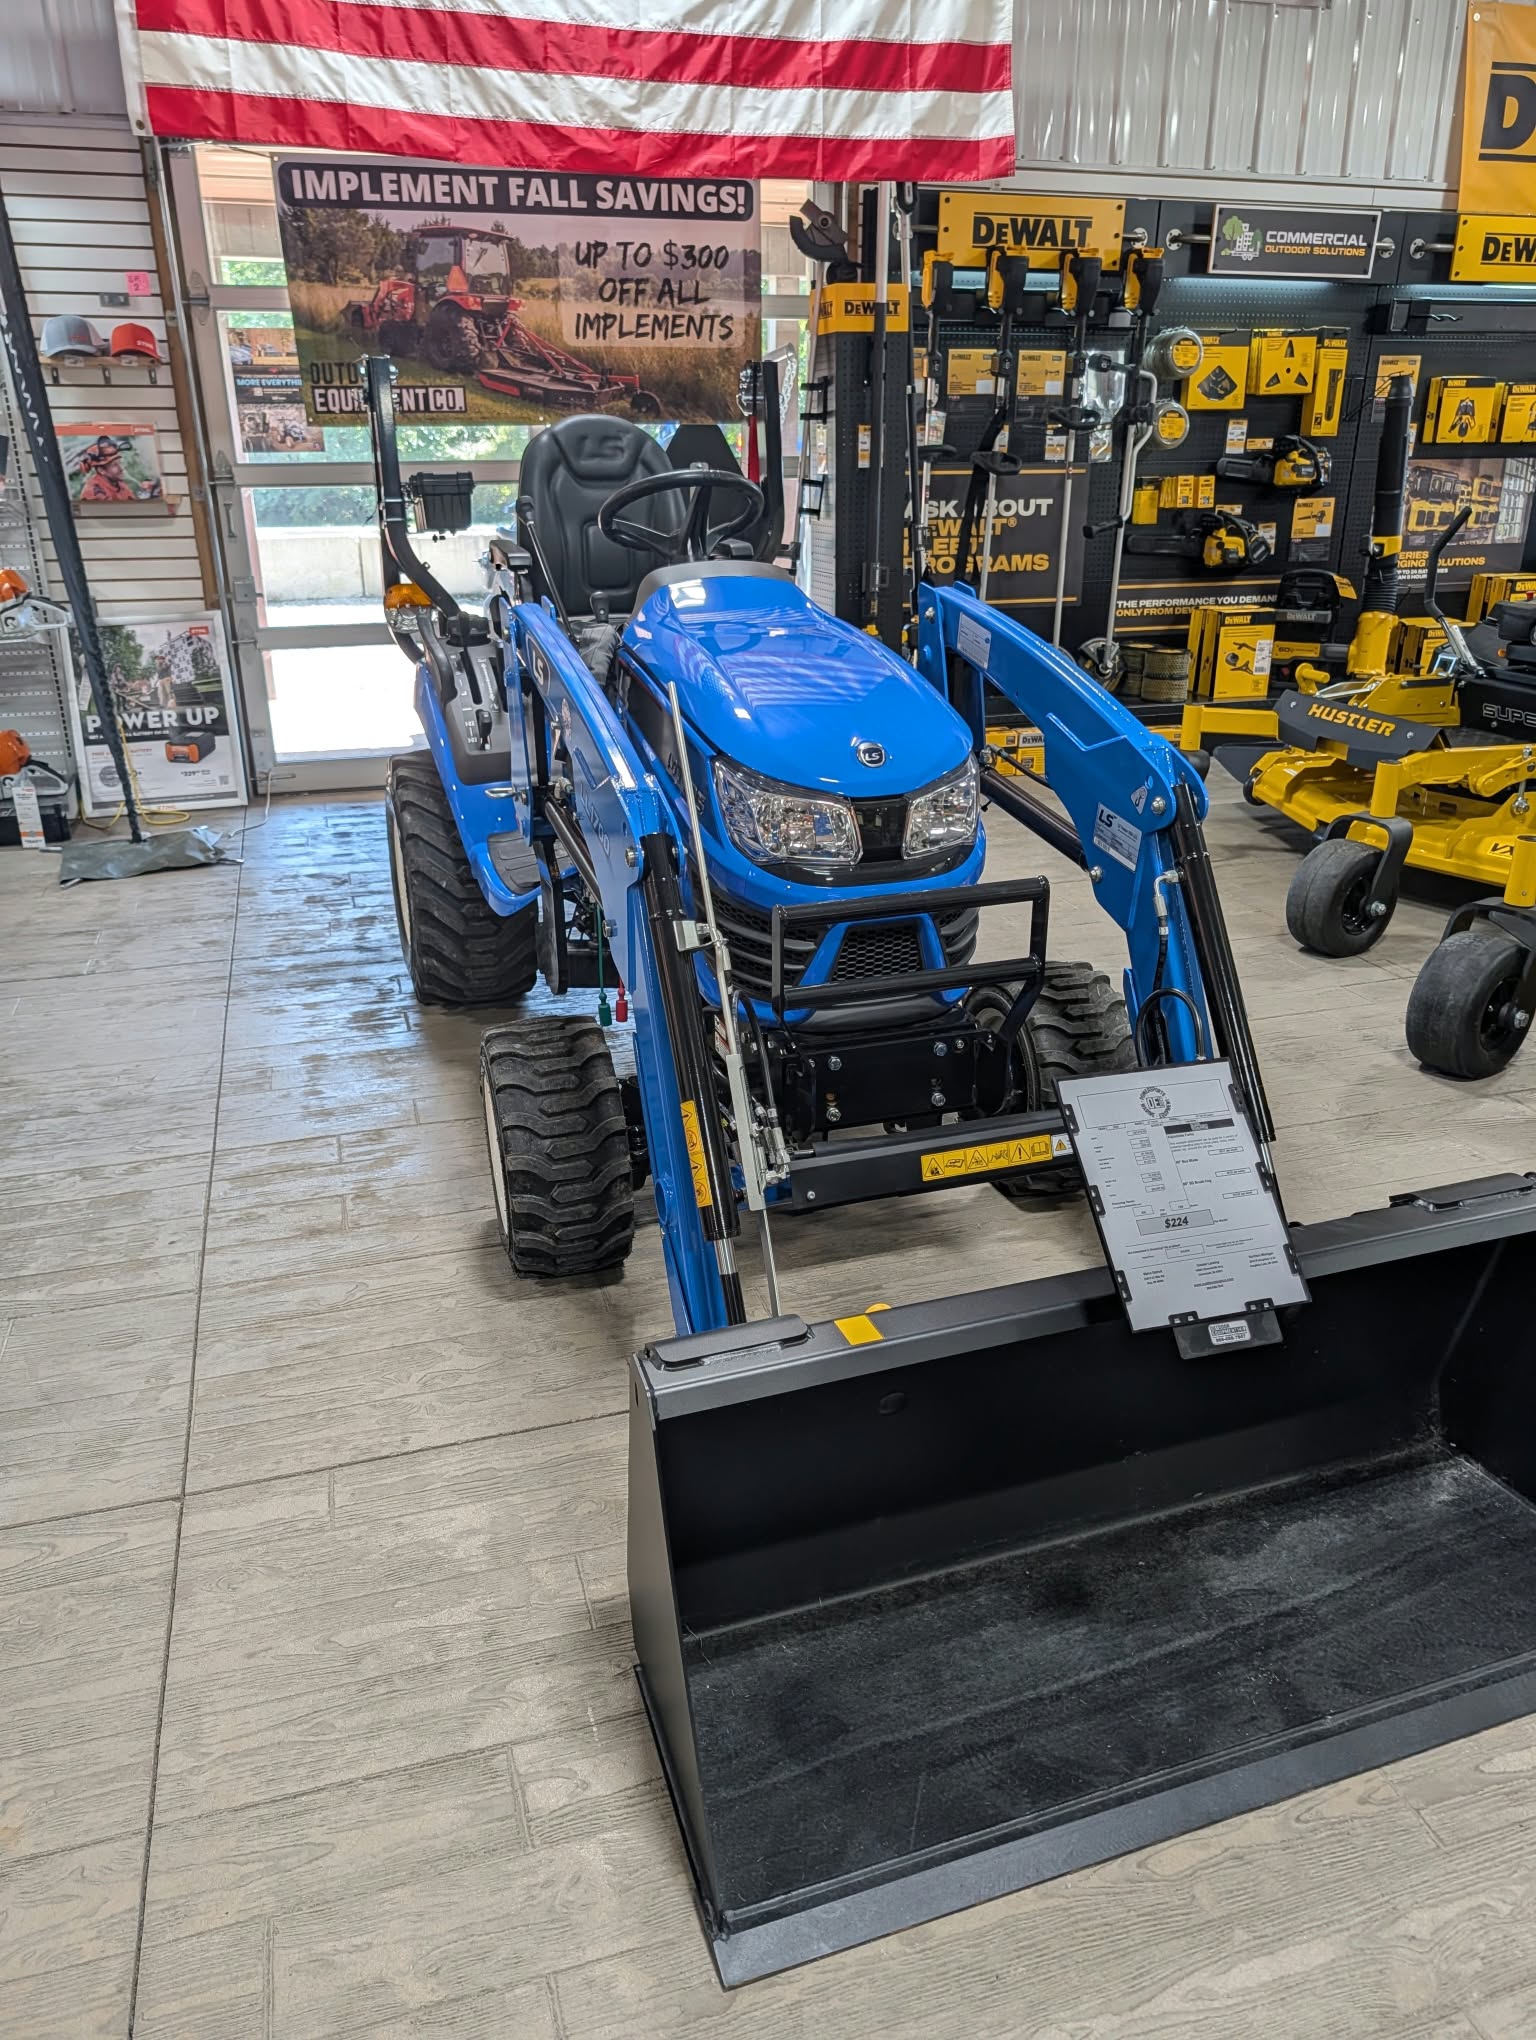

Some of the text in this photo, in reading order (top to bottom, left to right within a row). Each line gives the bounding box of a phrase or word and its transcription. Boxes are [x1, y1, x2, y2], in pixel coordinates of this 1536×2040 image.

[291, 169, 746, 214] IMPLEMENT FALL SAVINGS!
[972, 215, 1093, 248] DEWALT
[1266, 231, 1368, 246] COMMERCIAL
[575, 239, 729, 270] UP TO $300
[1264, 245, 1366, 256] OUTDOOR SOLUTIONS
[1481, 236, 1536, 263] DEW
[598, 278, 711, 307] OFF ALL
[844, 301, 900, 315] DEWLT
[575, 313, 734, 341] IMPLEMENTS
[237, 379, 303, 387] MORE EVERYTHI
[432, 389, 463, 410] CO.
[1398, 550, 1430, 560] ERIES
[1117, 594, 1278, 609] THE PERFORMANCE YOU DEMAN
[1116, 609, 1142, 617] ONLY
[1144, 607, 1174, 616] FROM
[532, 649, 544, 686] LS
[86, 706, 220, 734] PWER UP
[1307, 703, 1397, 737] HUSTLER
[865, 752, 881, 761] LS
[1098, 809, 1114, 828] LS
[1164, 1216, 1189, 1229] $224
